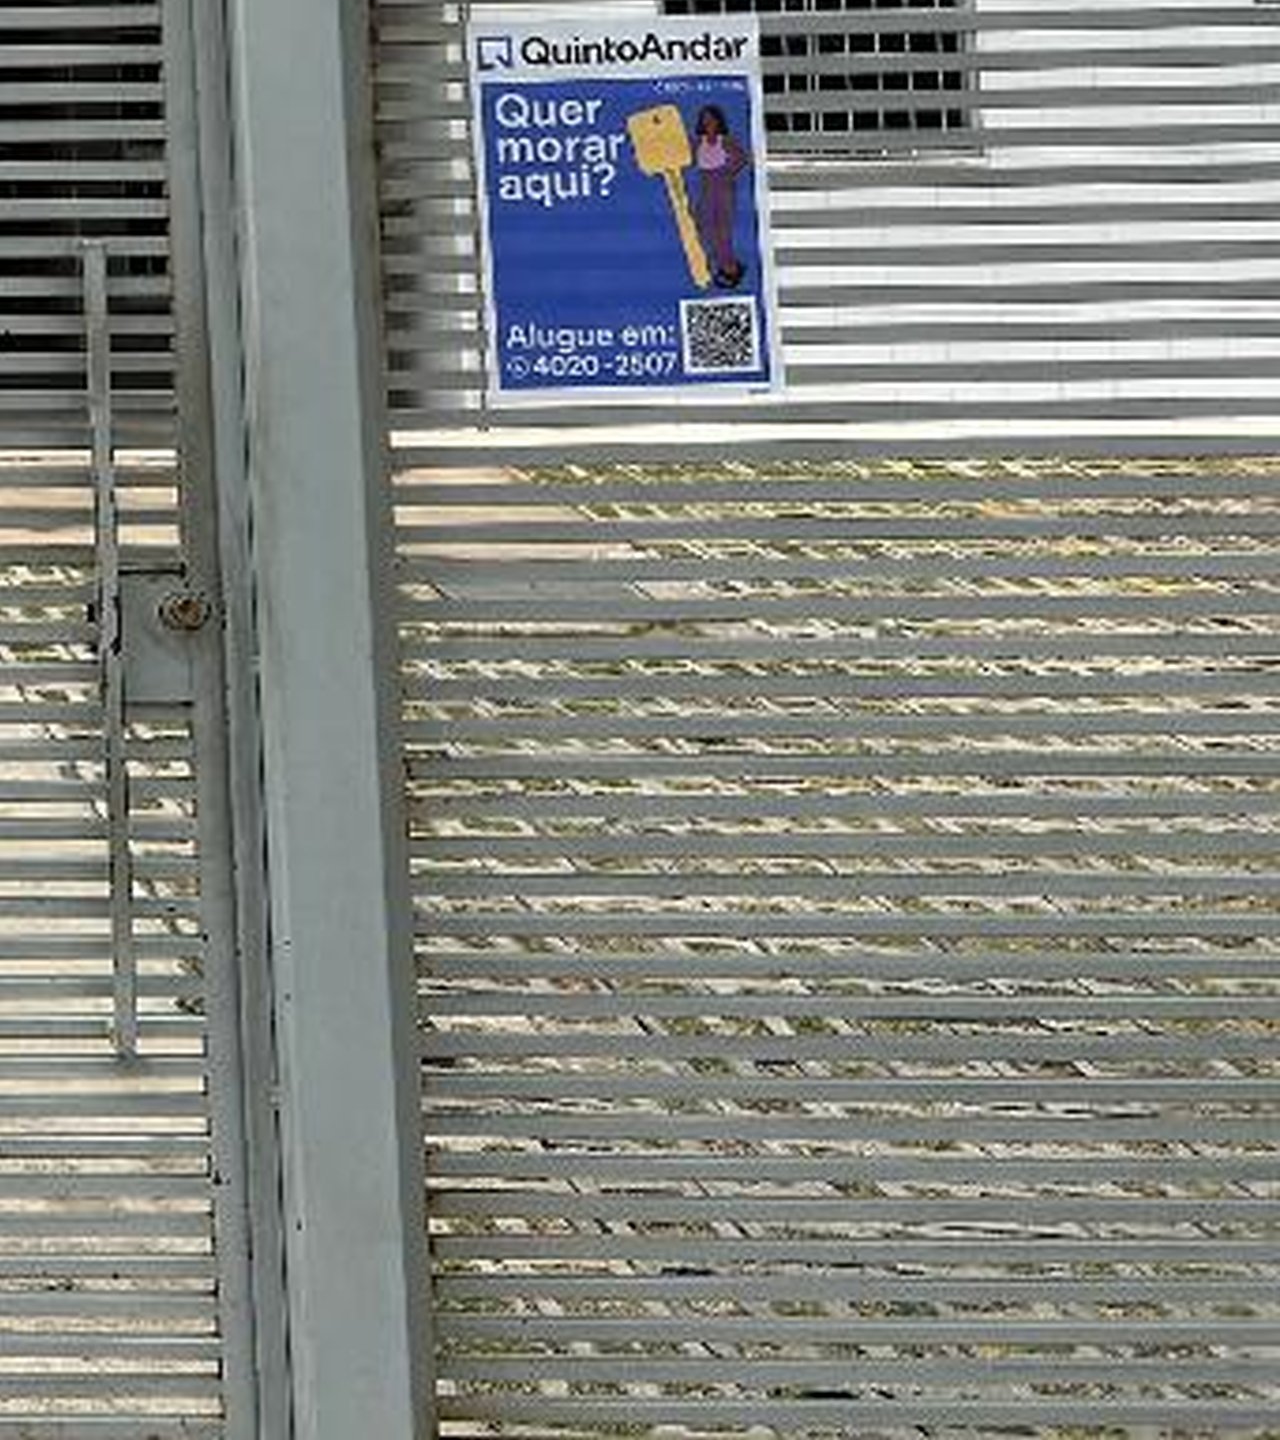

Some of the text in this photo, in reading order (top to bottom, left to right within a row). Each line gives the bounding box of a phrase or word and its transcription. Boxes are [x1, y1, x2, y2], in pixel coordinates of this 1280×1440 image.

[520, 32, 749, 67] QuintoAndar
[494, 92, 603, 129] Quer
[497, 132, 626, 163] morar
[498, 165, 617, 207] aqui?
[505, 323, 678, 354] Alugue em:
